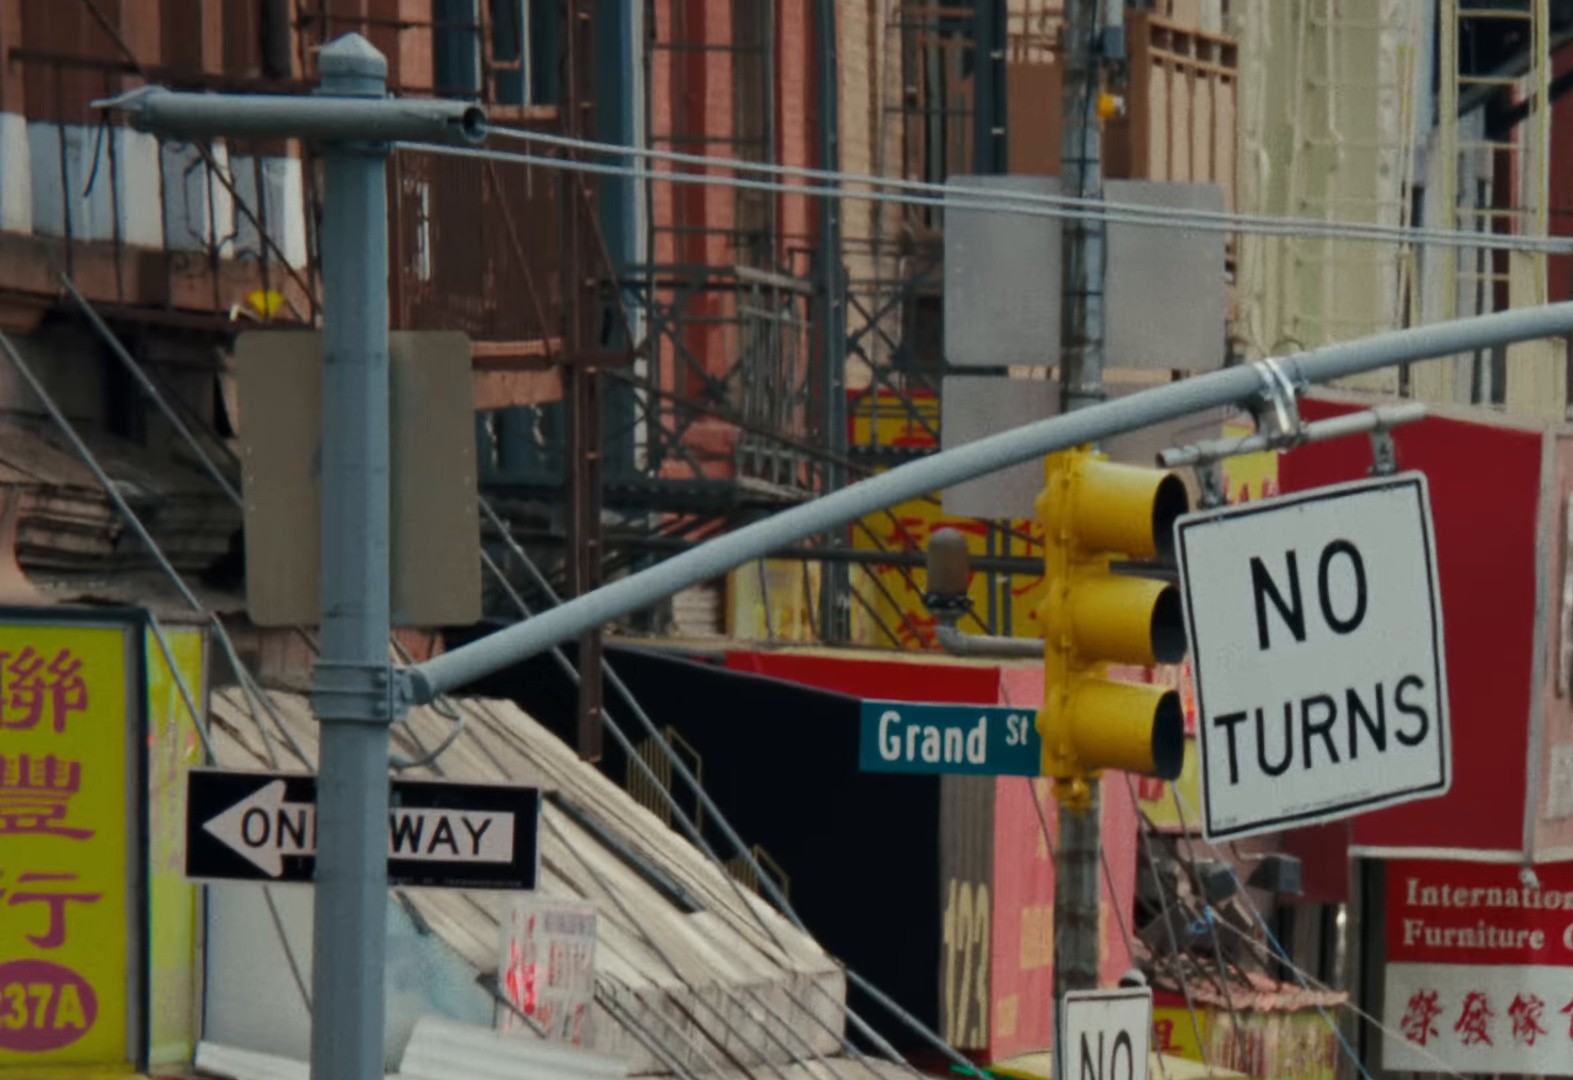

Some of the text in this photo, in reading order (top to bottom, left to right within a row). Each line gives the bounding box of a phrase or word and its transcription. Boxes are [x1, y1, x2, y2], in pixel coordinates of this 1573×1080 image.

[1250, 539, 1368, 651] NO
[878, 710, 1029, 764] Grand St
[1213, 675, 1430, 785] TURNS
[240, 807, 493, 856] ON WAY
[1402, 918, 1546, 950] Furniture
[0, 983, 87, 1031] 37A
